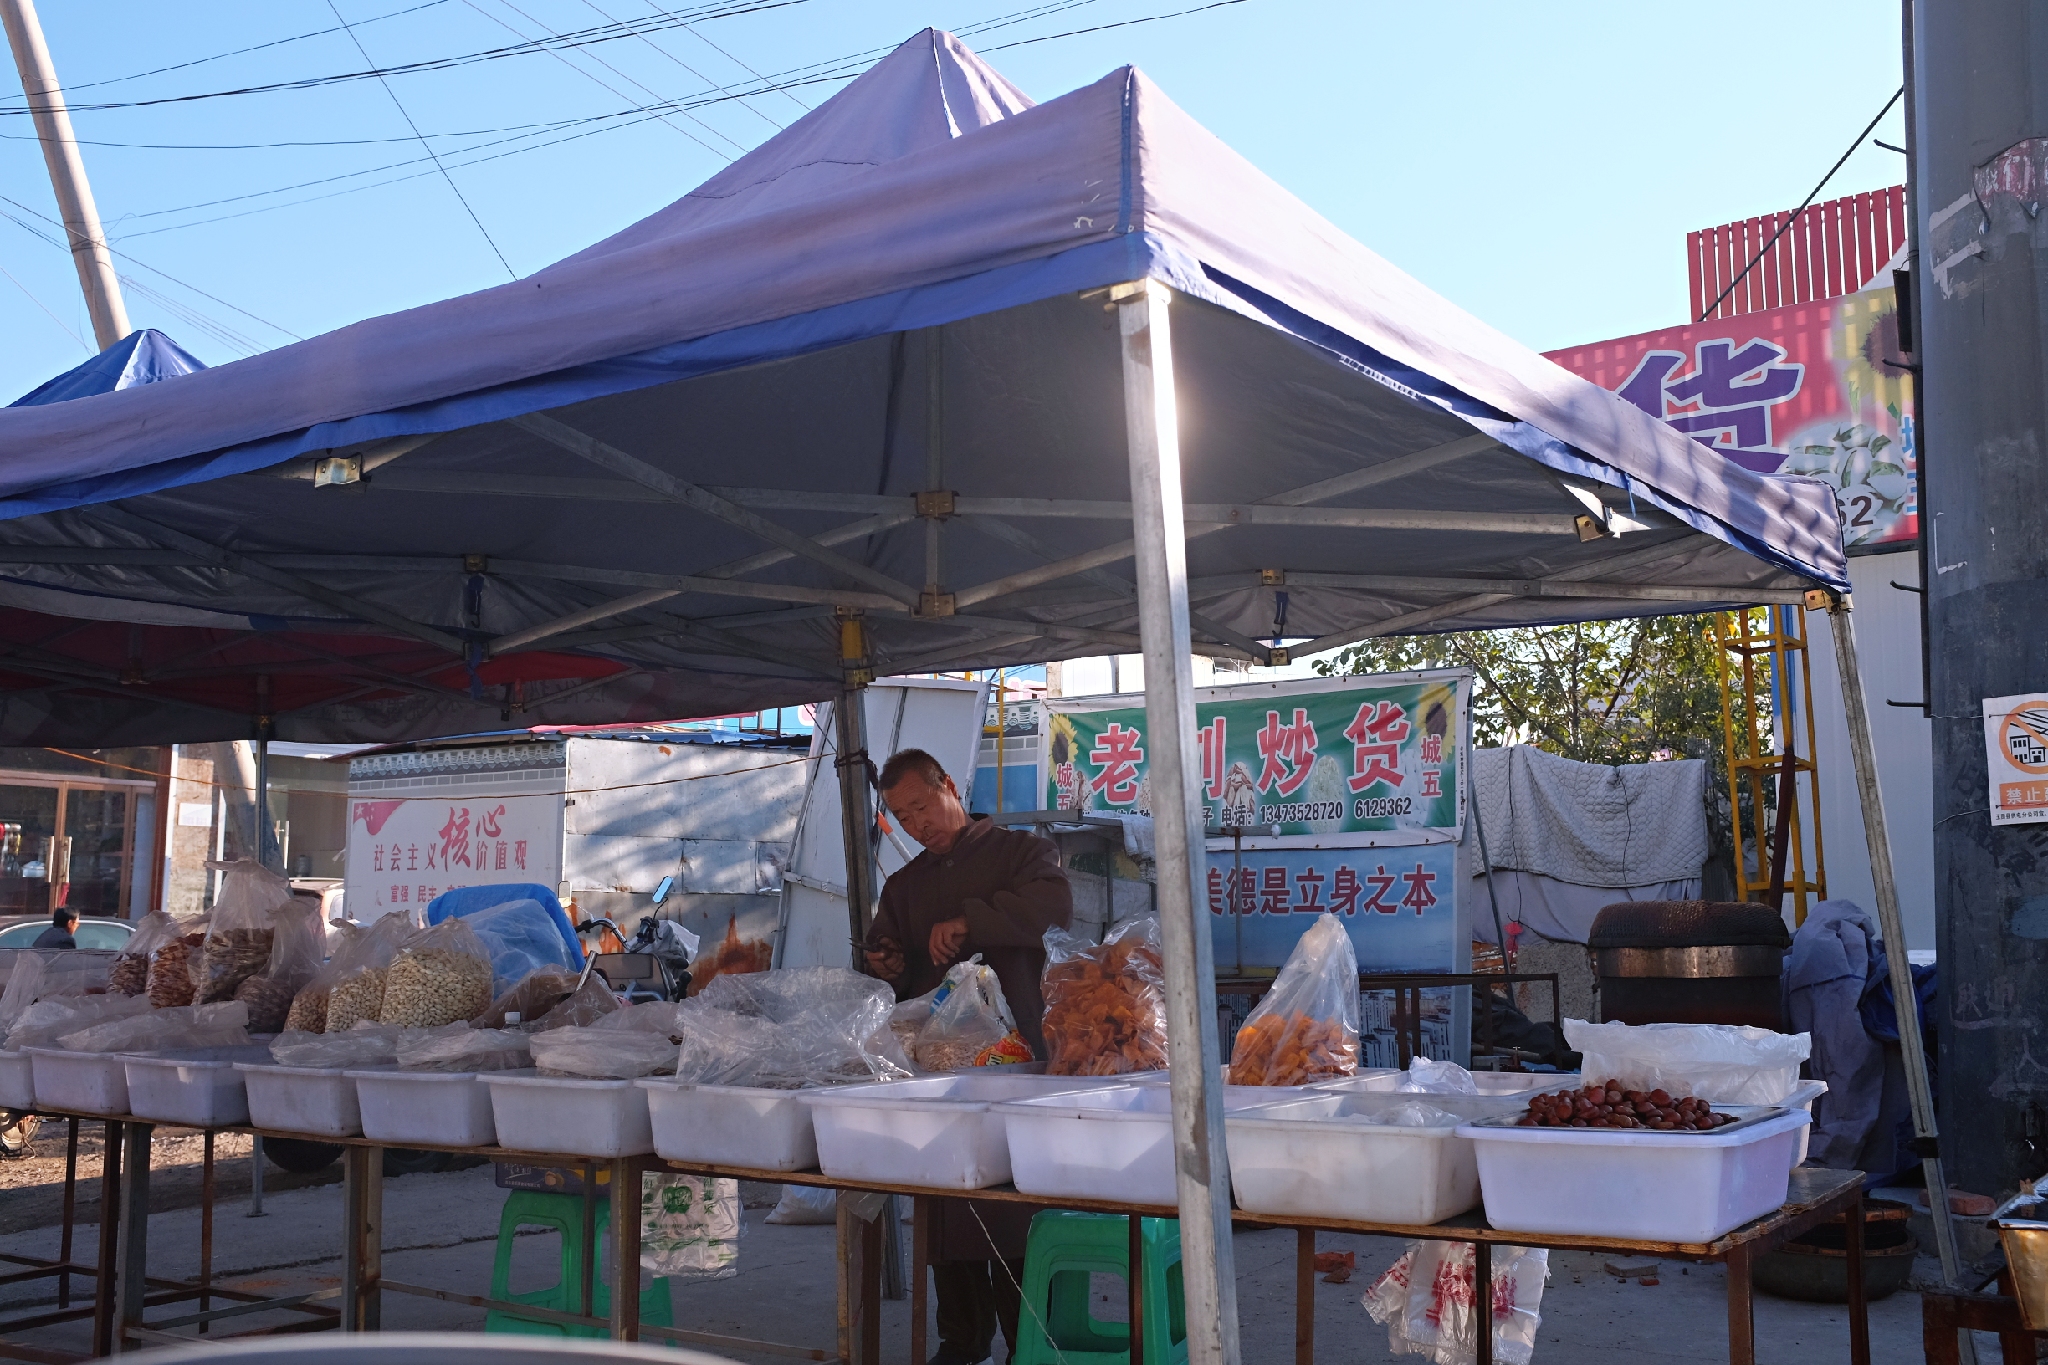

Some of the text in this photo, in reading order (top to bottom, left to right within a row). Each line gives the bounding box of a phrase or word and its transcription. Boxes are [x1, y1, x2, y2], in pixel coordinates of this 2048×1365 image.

[1421, 734, 1442, 797] 城五
[2006, 786, 2048, 805] 禁止
[1260, 802, 1343, 823] 13473528720
[1354, 797, 1412, 818] 6129362
[374, 804, 527, 872] 社会主义 核心 价值观
[391, 884, 409, 902] 富强
